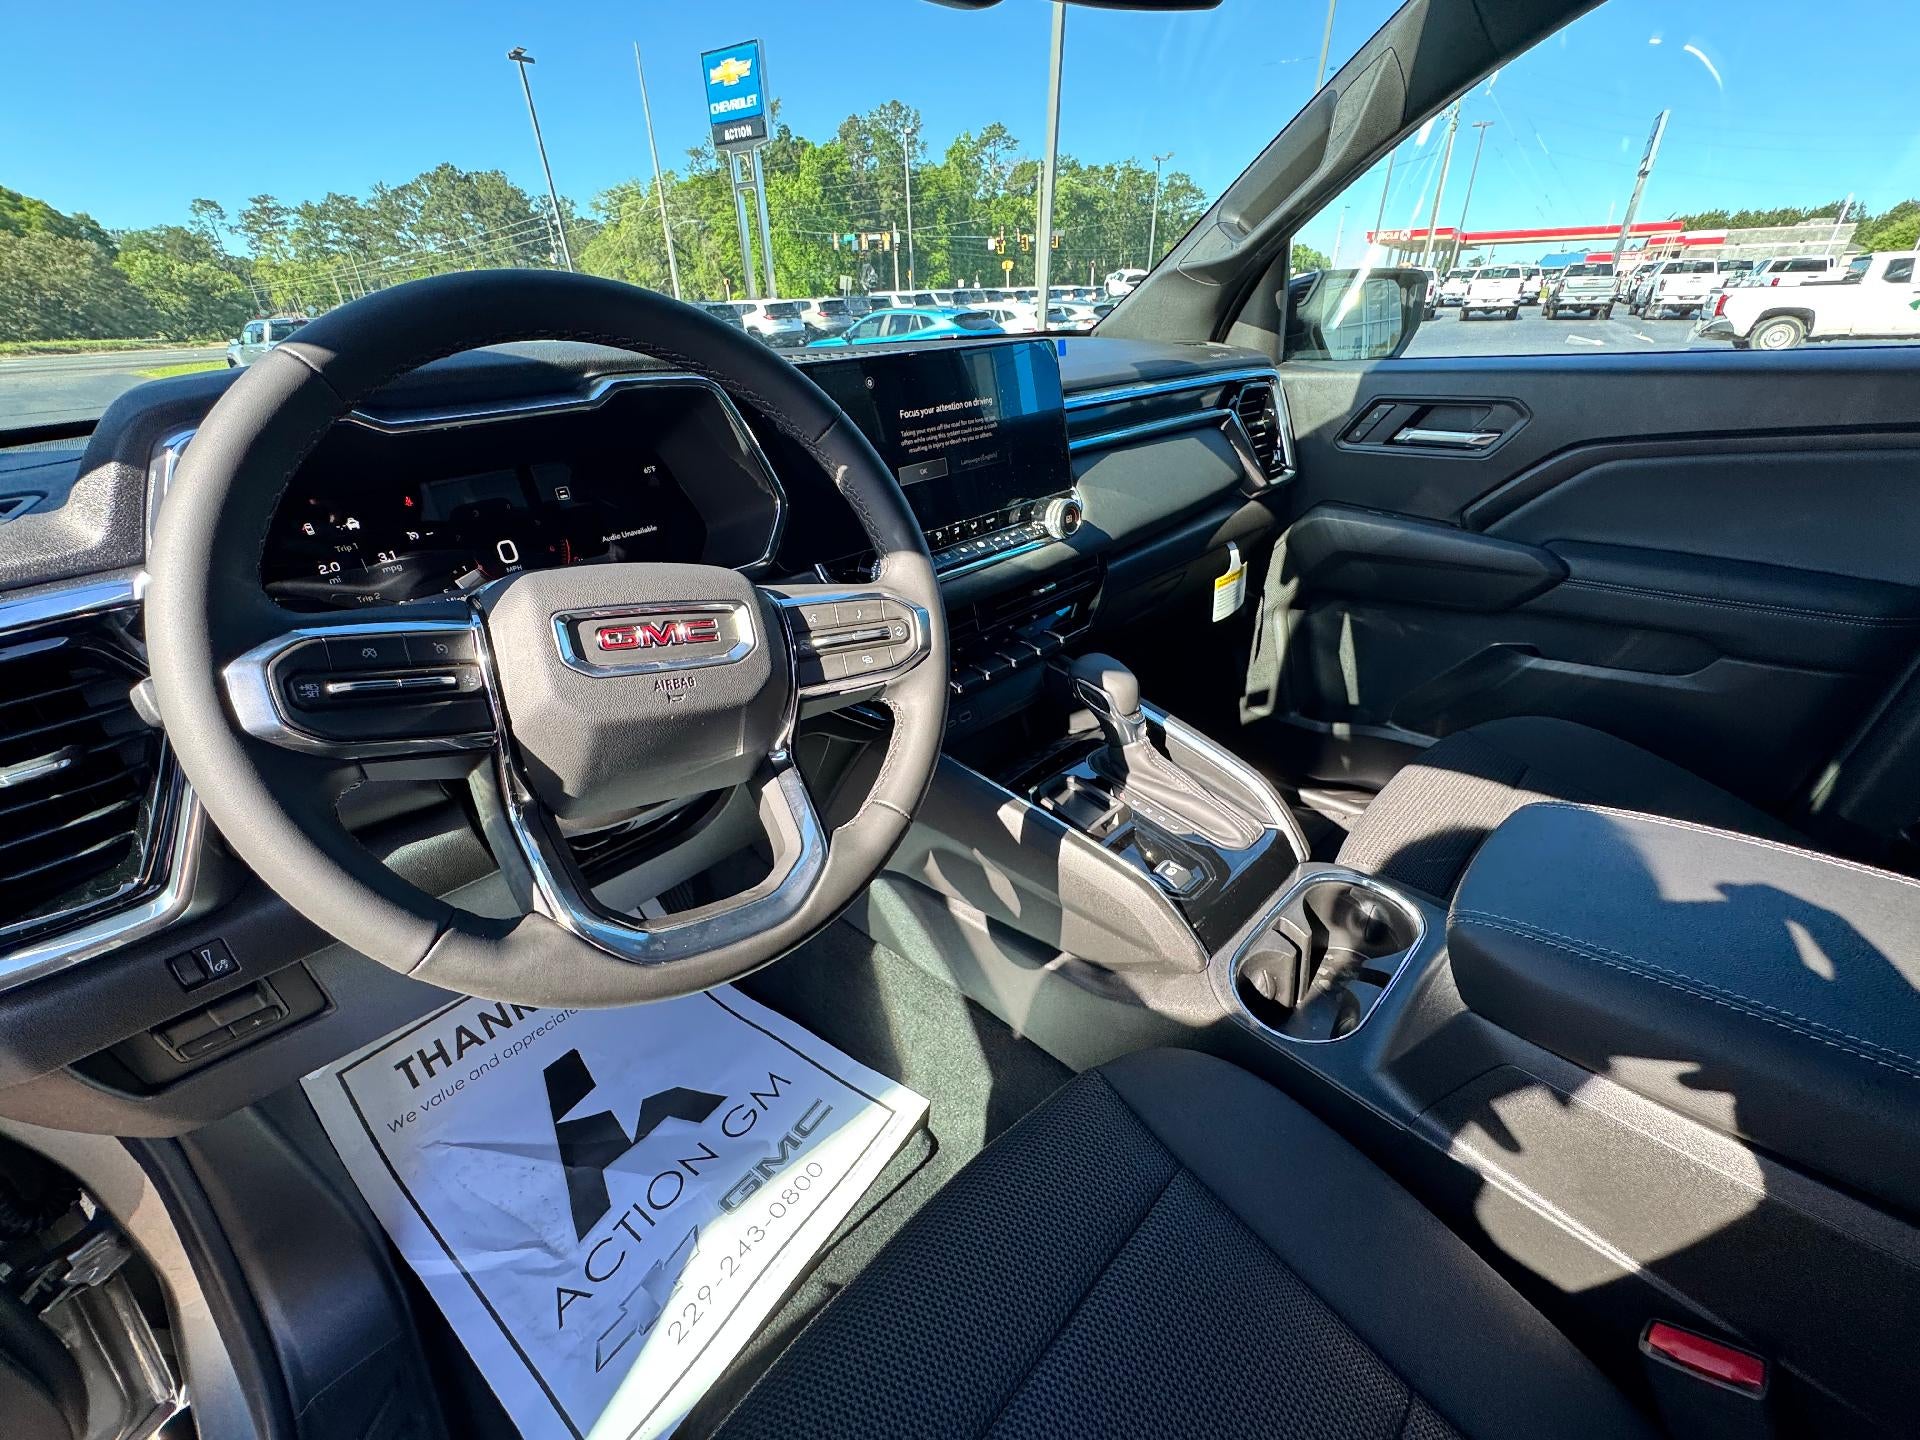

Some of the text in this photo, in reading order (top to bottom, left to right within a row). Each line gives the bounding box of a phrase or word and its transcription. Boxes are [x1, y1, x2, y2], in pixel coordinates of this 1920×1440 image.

[710, 94, 758, 115] CHEVROLET
[724, 125, 753, 141] ACTION
[900, 409, 920, 419] Focus
[919, 408, 934, 418] your
[935, 402, 963, 412] attention
[973, 396, 993, 407] driving
[920, 467, 928, 475] OK
[602, 524, 658, 543] Audio Unavailable
[334, 544, 352, 553] Trip
[378, 550, 397, 563] 3.1
[496, 539, 519, 564] 0
[318, 561, 341, 575] 2.0
[382, 563, 403, 574] mpg
[505, 564, 522, 574] MPH
[328, 575, 342, 585] mi
[357, 592, 381, 604] Trip 2
[597, 619, 720, 651] GMC
[653, 675, 696, 692] AIRBAG
[387, 1111, 416, 1133] We
[420, 1078, 465, 1111] value
[469, 1053, 500, 1081] and
[717, 1098, 833, 1215] GMC
[556, 1071, 792, 1329] ACTION GM
[667, 1162, 823, 1345] 229-243-0800
